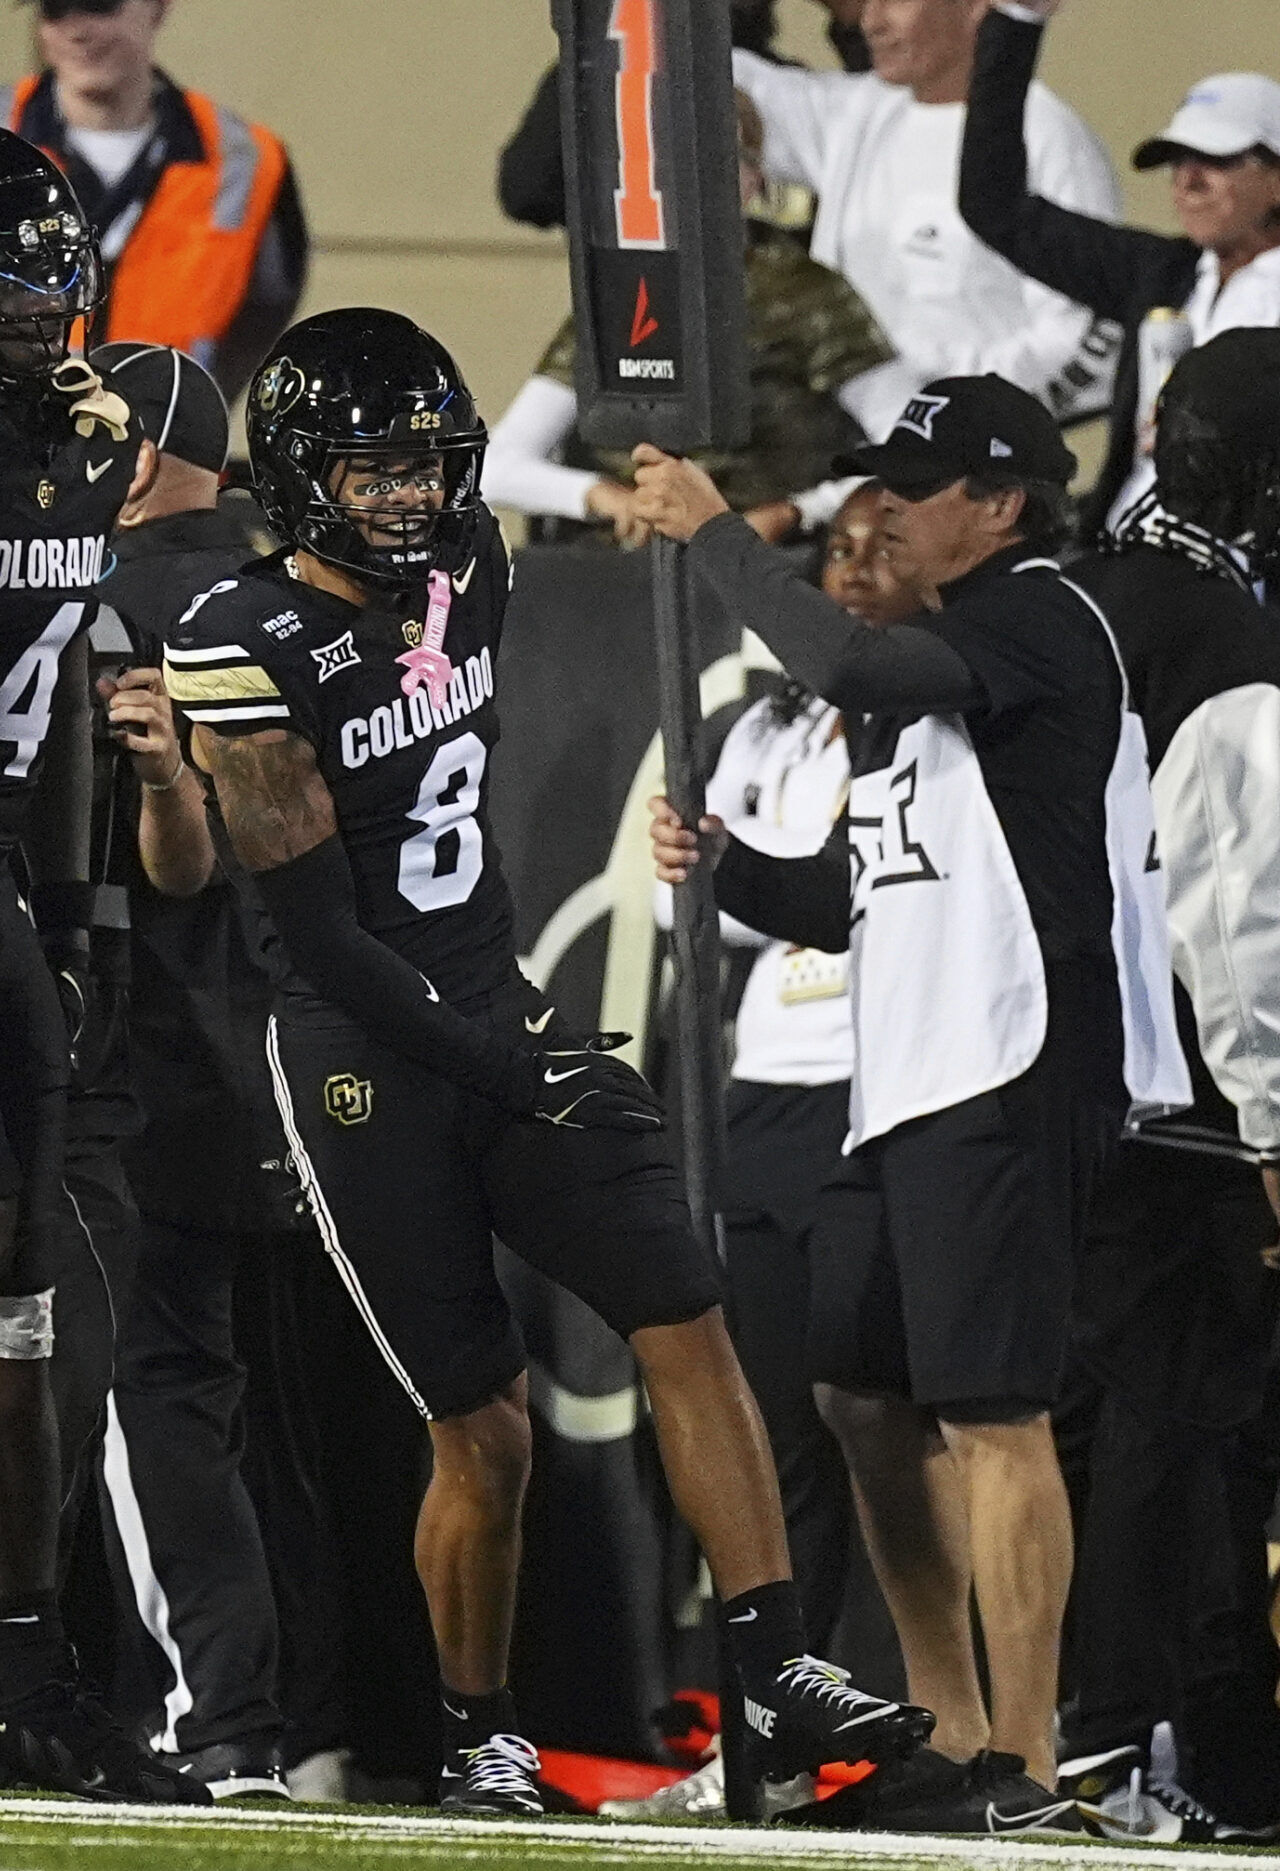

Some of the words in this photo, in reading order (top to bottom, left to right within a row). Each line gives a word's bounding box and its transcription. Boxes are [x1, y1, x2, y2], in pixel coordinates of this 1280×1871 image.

[607, 0, 665, 249] 1
[262, 610, 299, 633] mac
[275, 620, 304, 640] 82-94
[315, 637, 357, 677] XII
[397, 731, 487, 912] 8
[323, 1073, 373, 1125] CU
